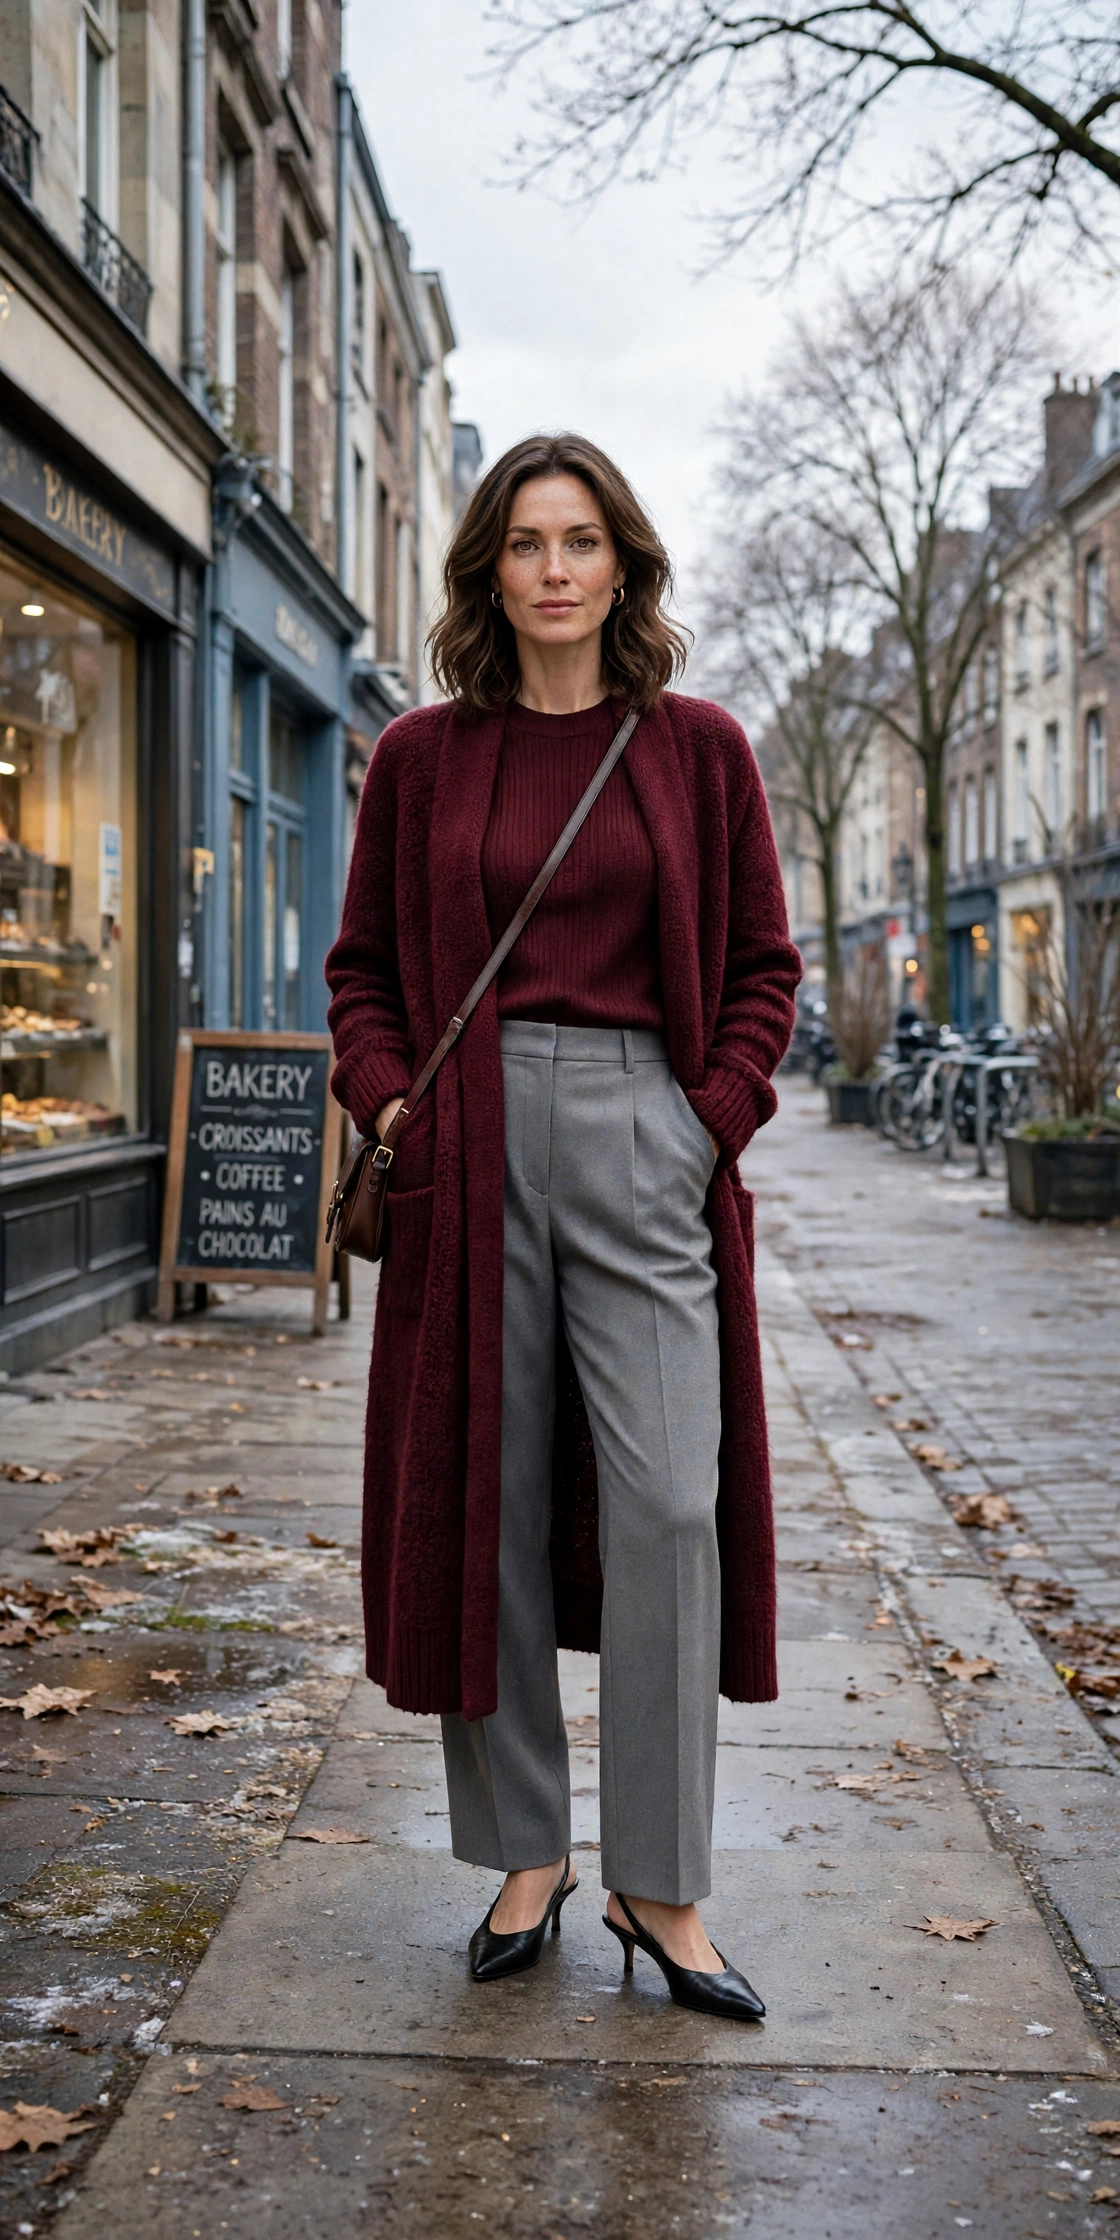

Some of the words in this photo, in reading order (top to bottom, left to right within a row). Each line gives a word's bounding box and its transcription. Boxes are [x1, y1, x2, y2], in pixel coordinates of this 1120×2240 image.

[206, 1061, 312, 1101] BAKERY
[199, 1122, 313, 1155] CROISSANTS
[216, 1162, 286, 1192] COFFEE
[199, 1198, 255, 1227] PAINS
[259, 1201, 287, 1228] AU
[198, 1230, 294, 1260] CHOCOLAT
